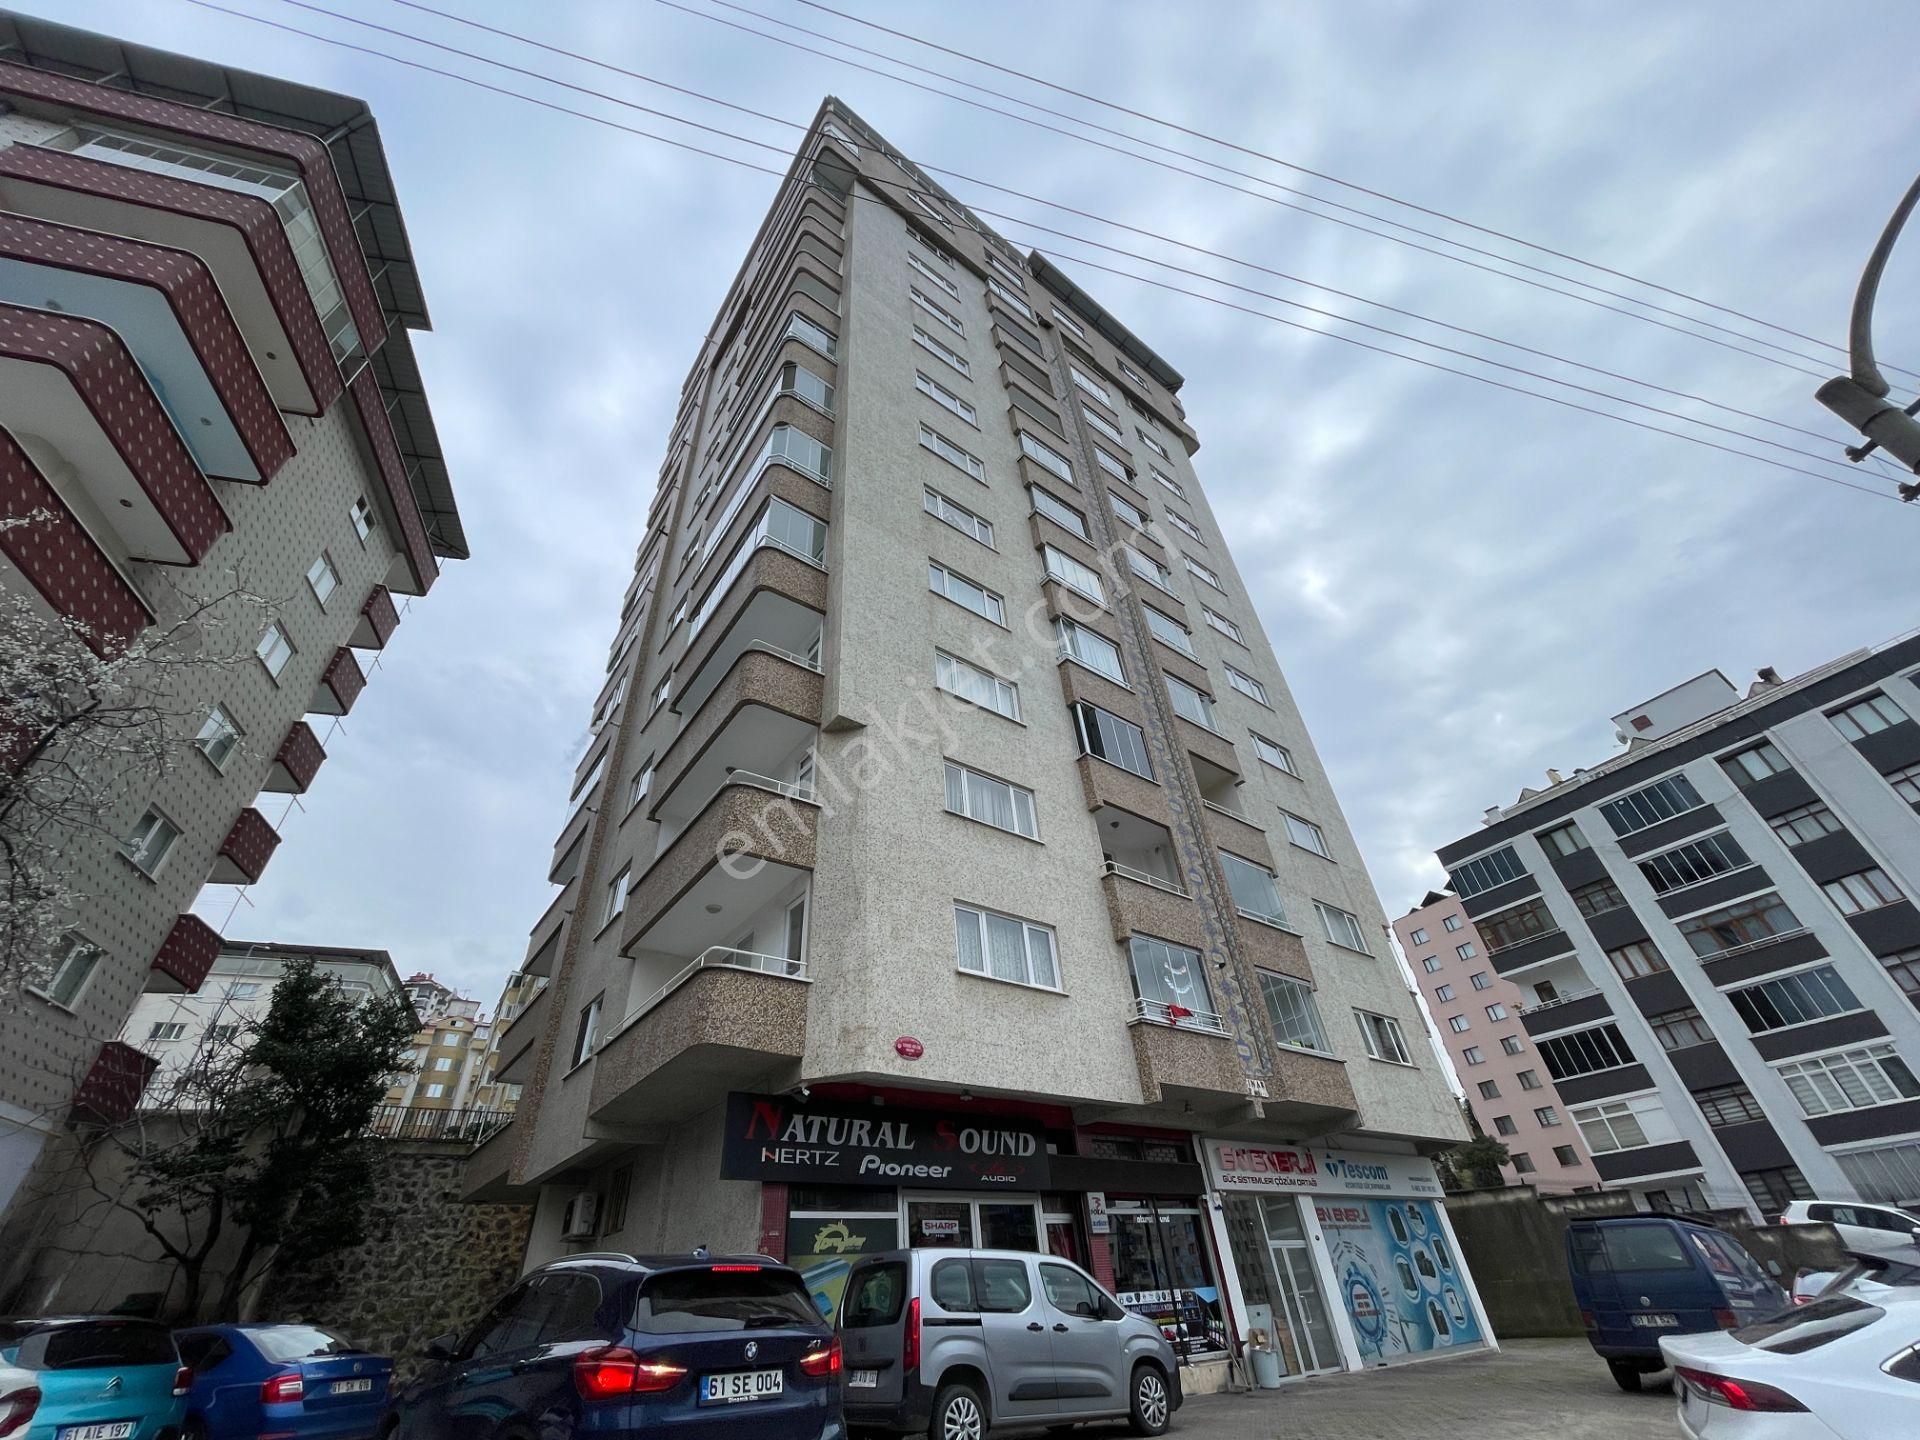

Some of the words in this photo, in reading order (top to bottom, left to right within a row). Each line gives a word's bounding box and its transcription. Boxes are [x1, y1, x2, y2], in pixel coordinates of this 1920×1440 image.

[744, 1101, 915, 1150] NATURAL
[933, 1120, 1036, 1156] SOUND
[761, 1147, 840, 1166] HERTZ
[859, 1154, 952, 1178] Pioneer
[1338, 1160, 1389, 1180] Tescom
[925, 1222, 957, 1230] SHARP
[709, 1378, 725, 1397] 61
[732, 1375, 751, 1394] SE
[756, 1373, 780, 1392] 004
[65, 1428, 79, 1440] 61
[84, 1426, 105, 1439] AIE
[110, 1424, 129, 1437] 197
